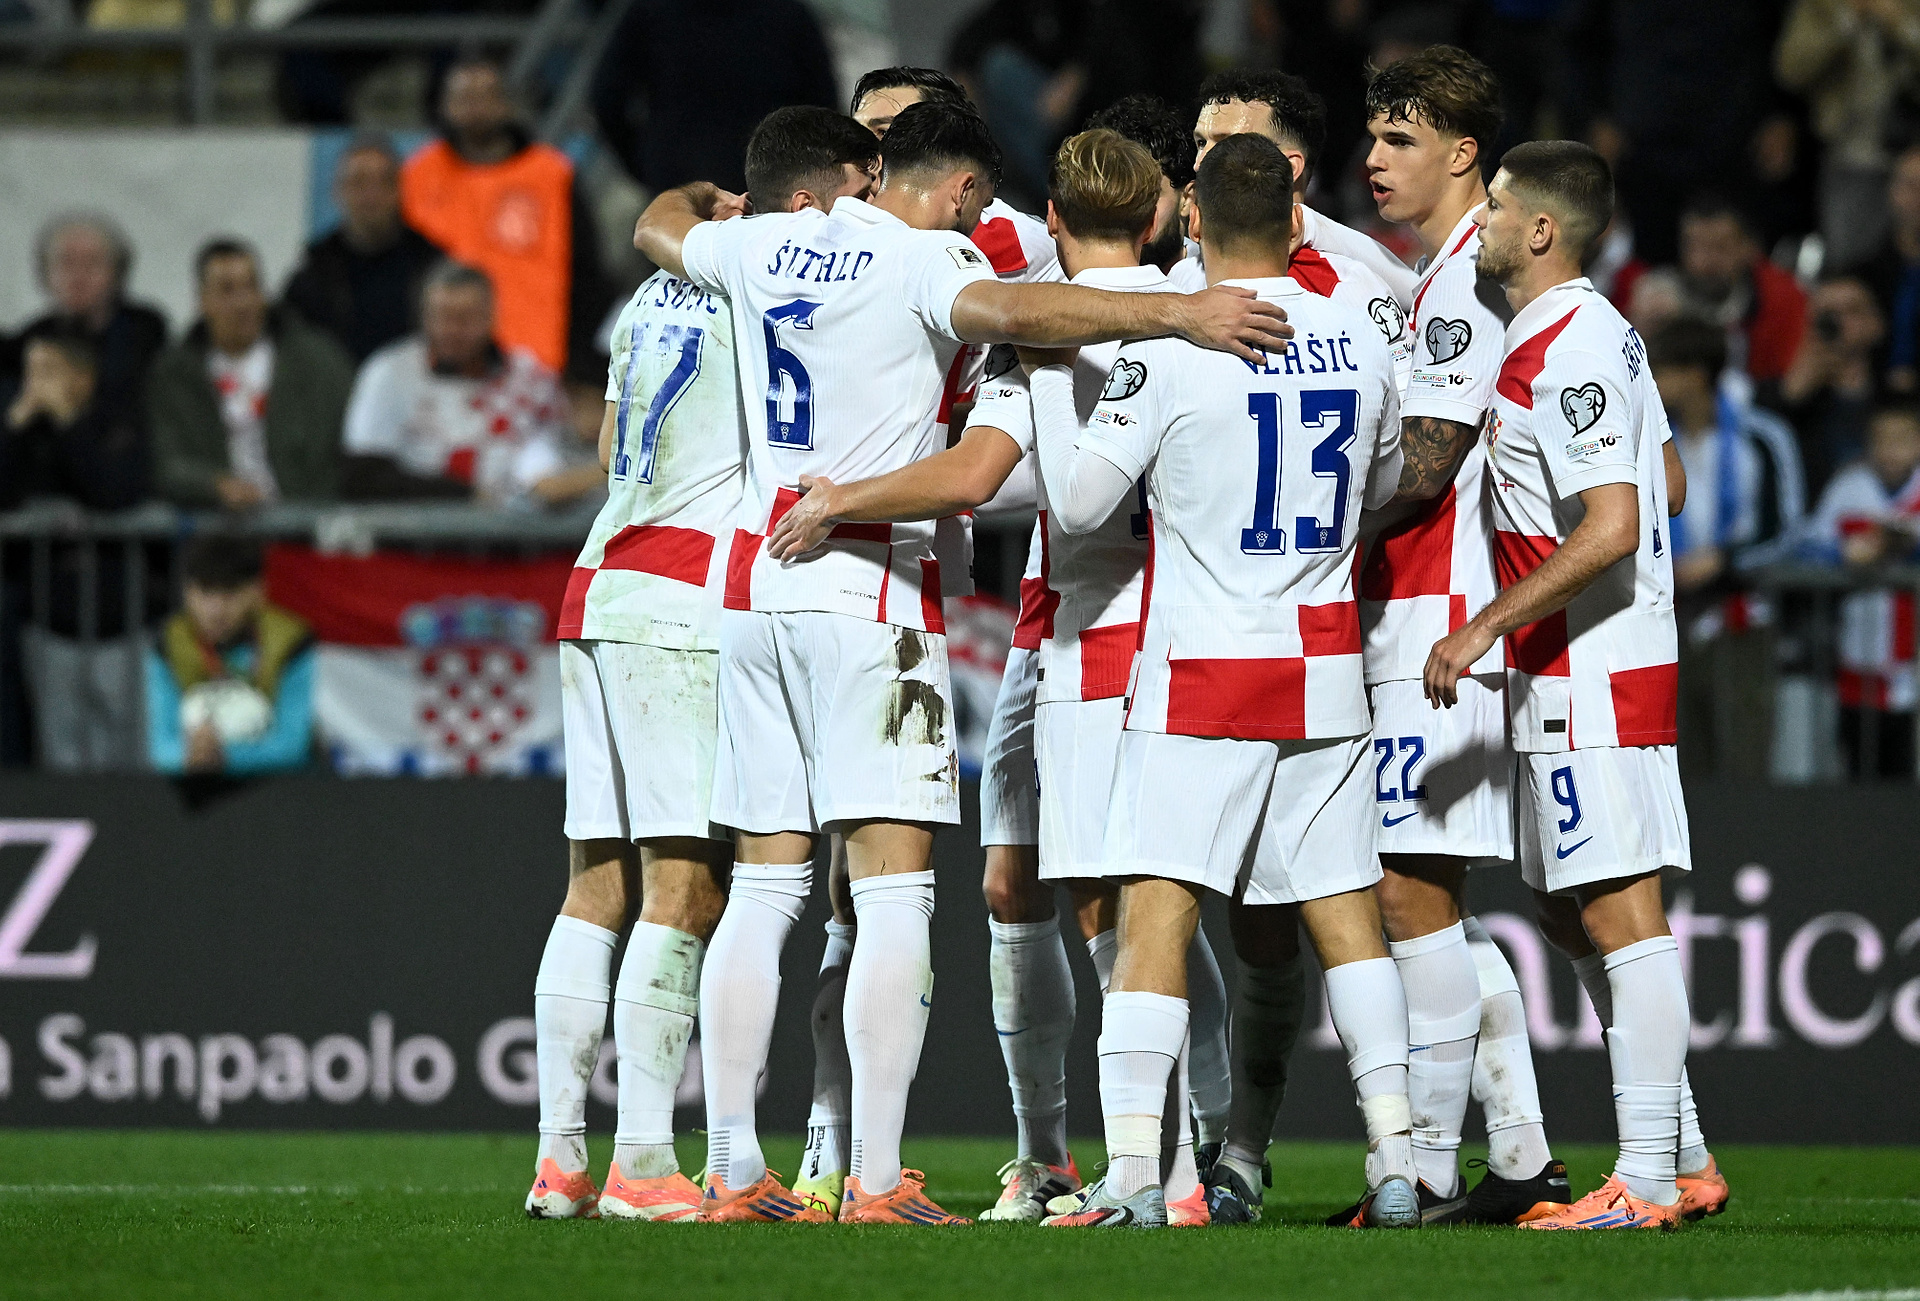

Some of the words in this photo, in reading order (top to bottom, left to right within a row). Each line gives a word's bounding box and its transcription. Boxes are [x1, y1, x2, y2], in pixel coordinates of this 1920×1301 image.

[614, 321, 705, 485] 17
[763, 299, 824, 451] 6
[1240, 389, 1361, 555] 13
[1374, 736, 1428, 804] 22
[1551, 765, 1585, 835] 9
[38, 1010, 457, 1122] Sanpaolo
